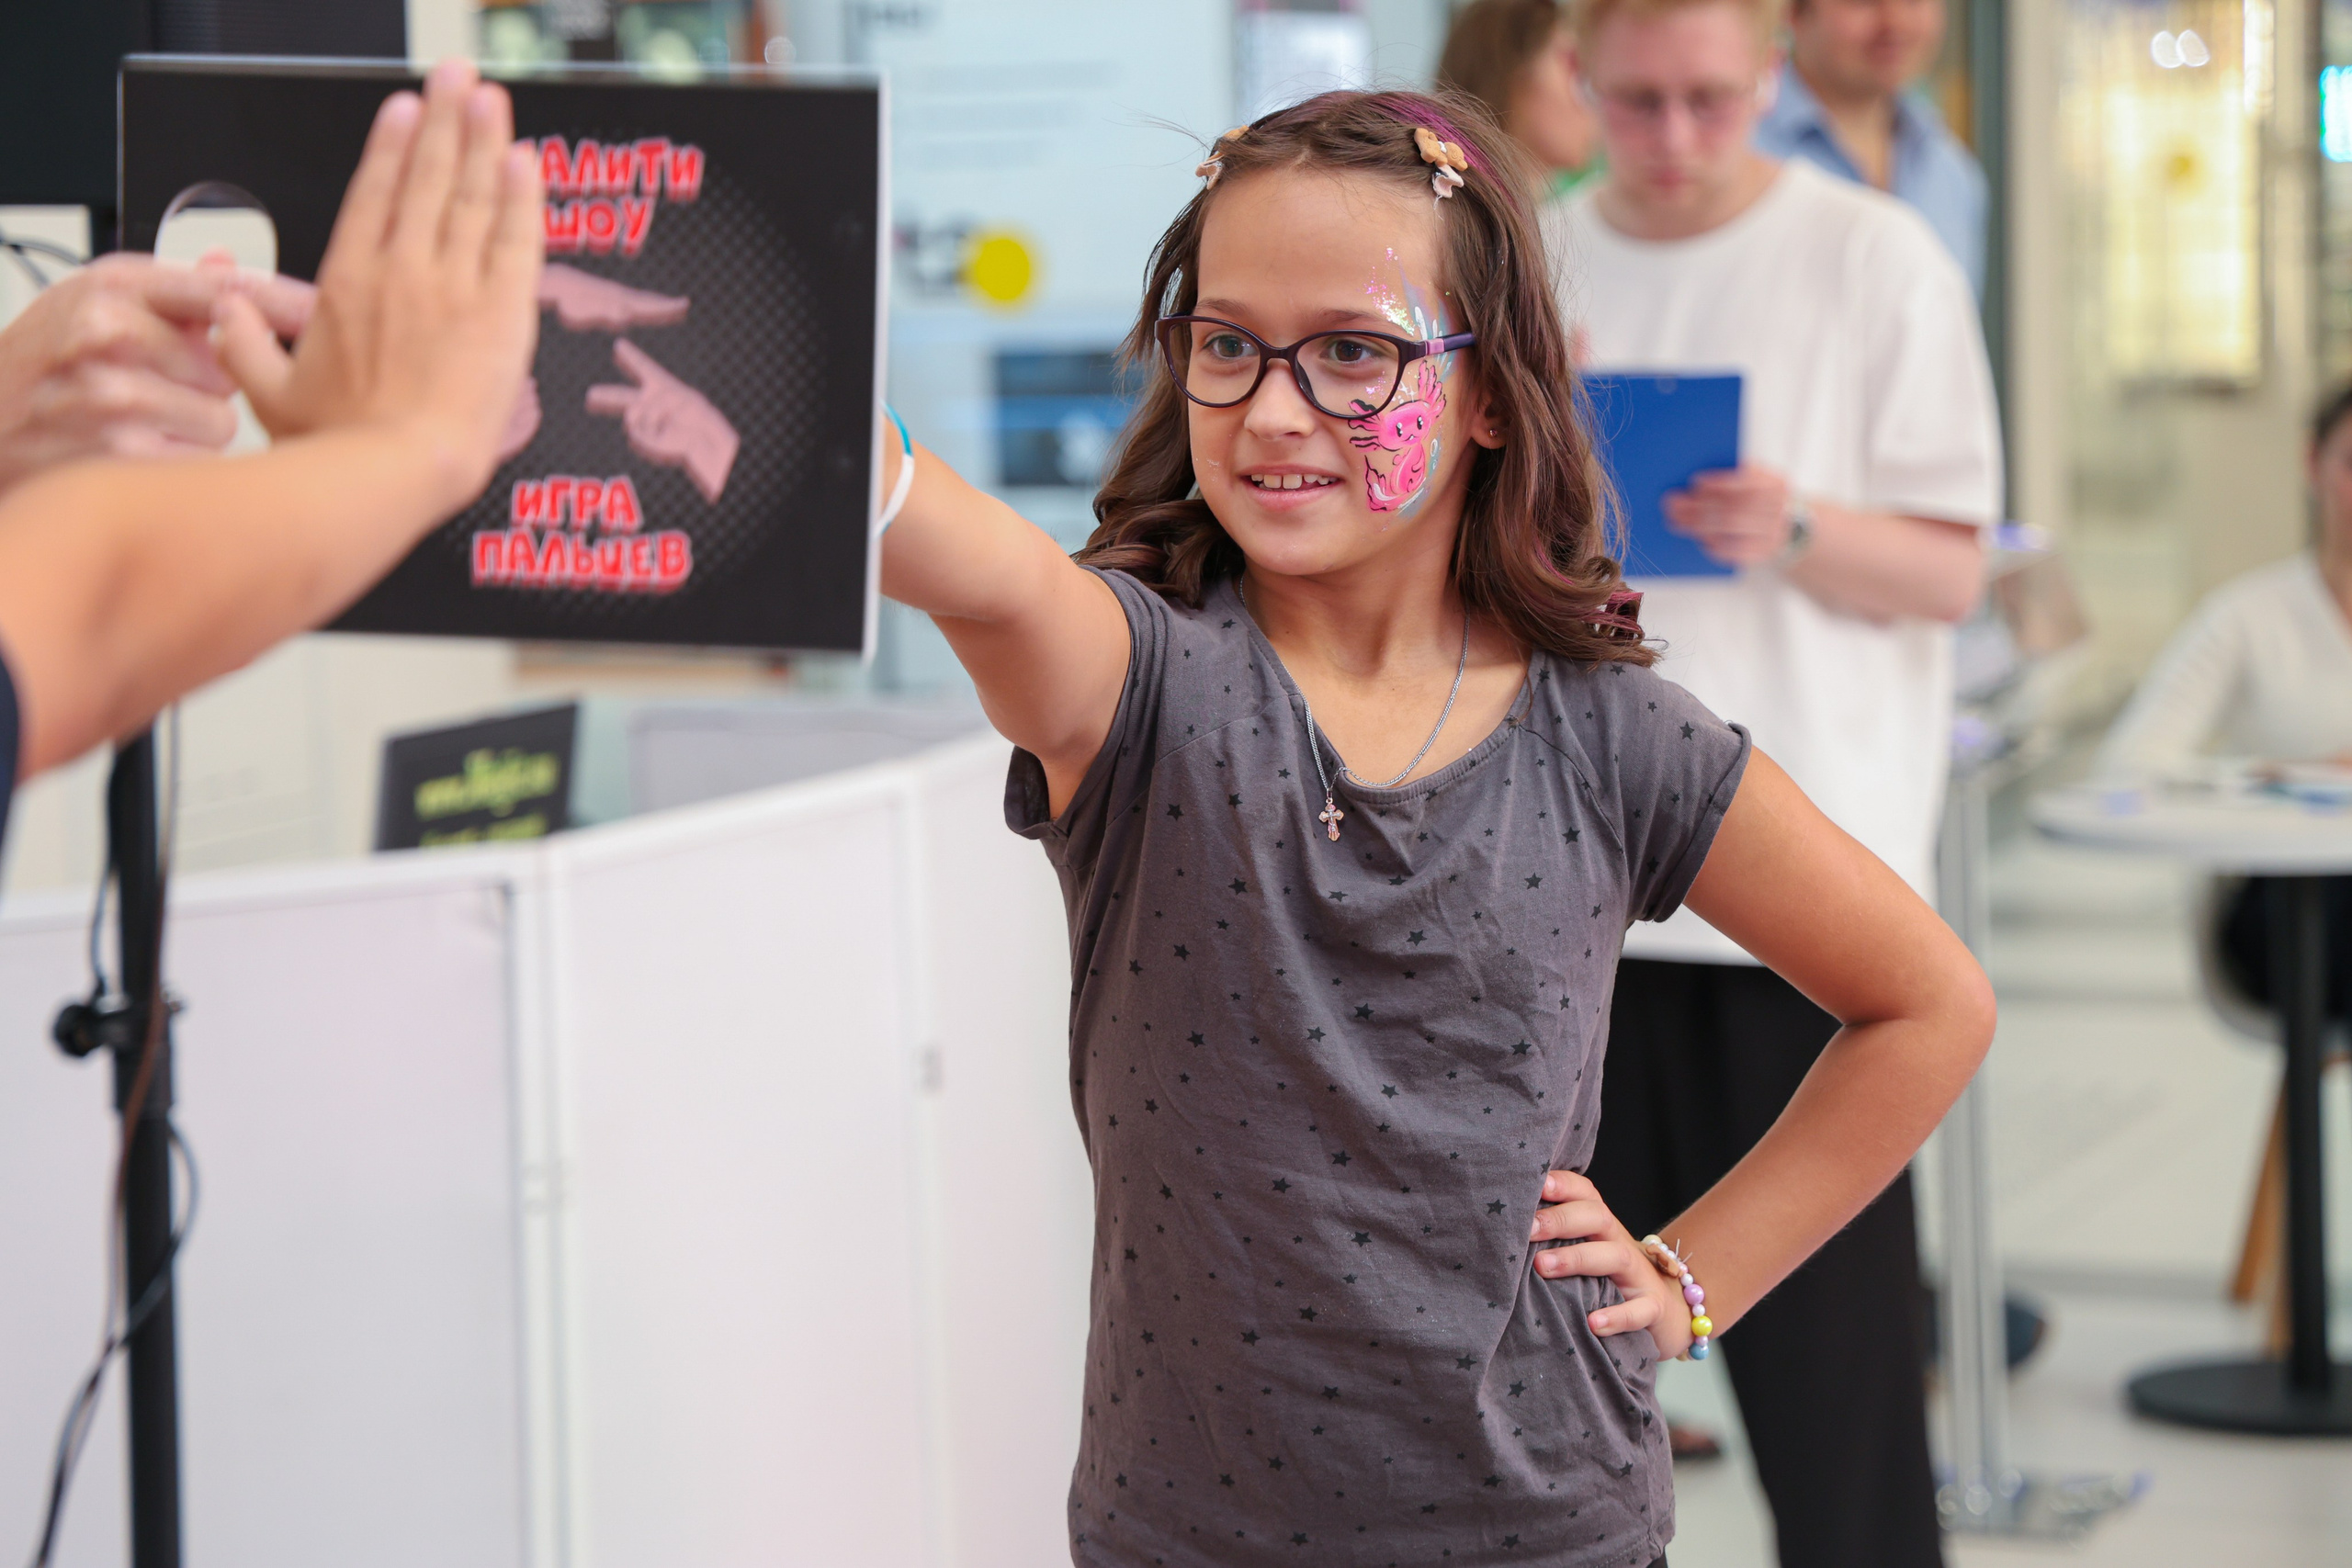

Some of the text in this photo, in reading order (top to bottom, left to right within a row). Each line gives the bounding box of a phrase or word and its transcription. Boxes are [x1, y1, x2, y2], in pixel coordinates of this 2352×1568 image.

[515, 135, 705, 202] АЛИТИ
[543, 194, 658, 257] ШОУ
[511, 475, 642, 532] ИГРА
[471, 527, 693, 593] ПАЛЬЦЕВ
